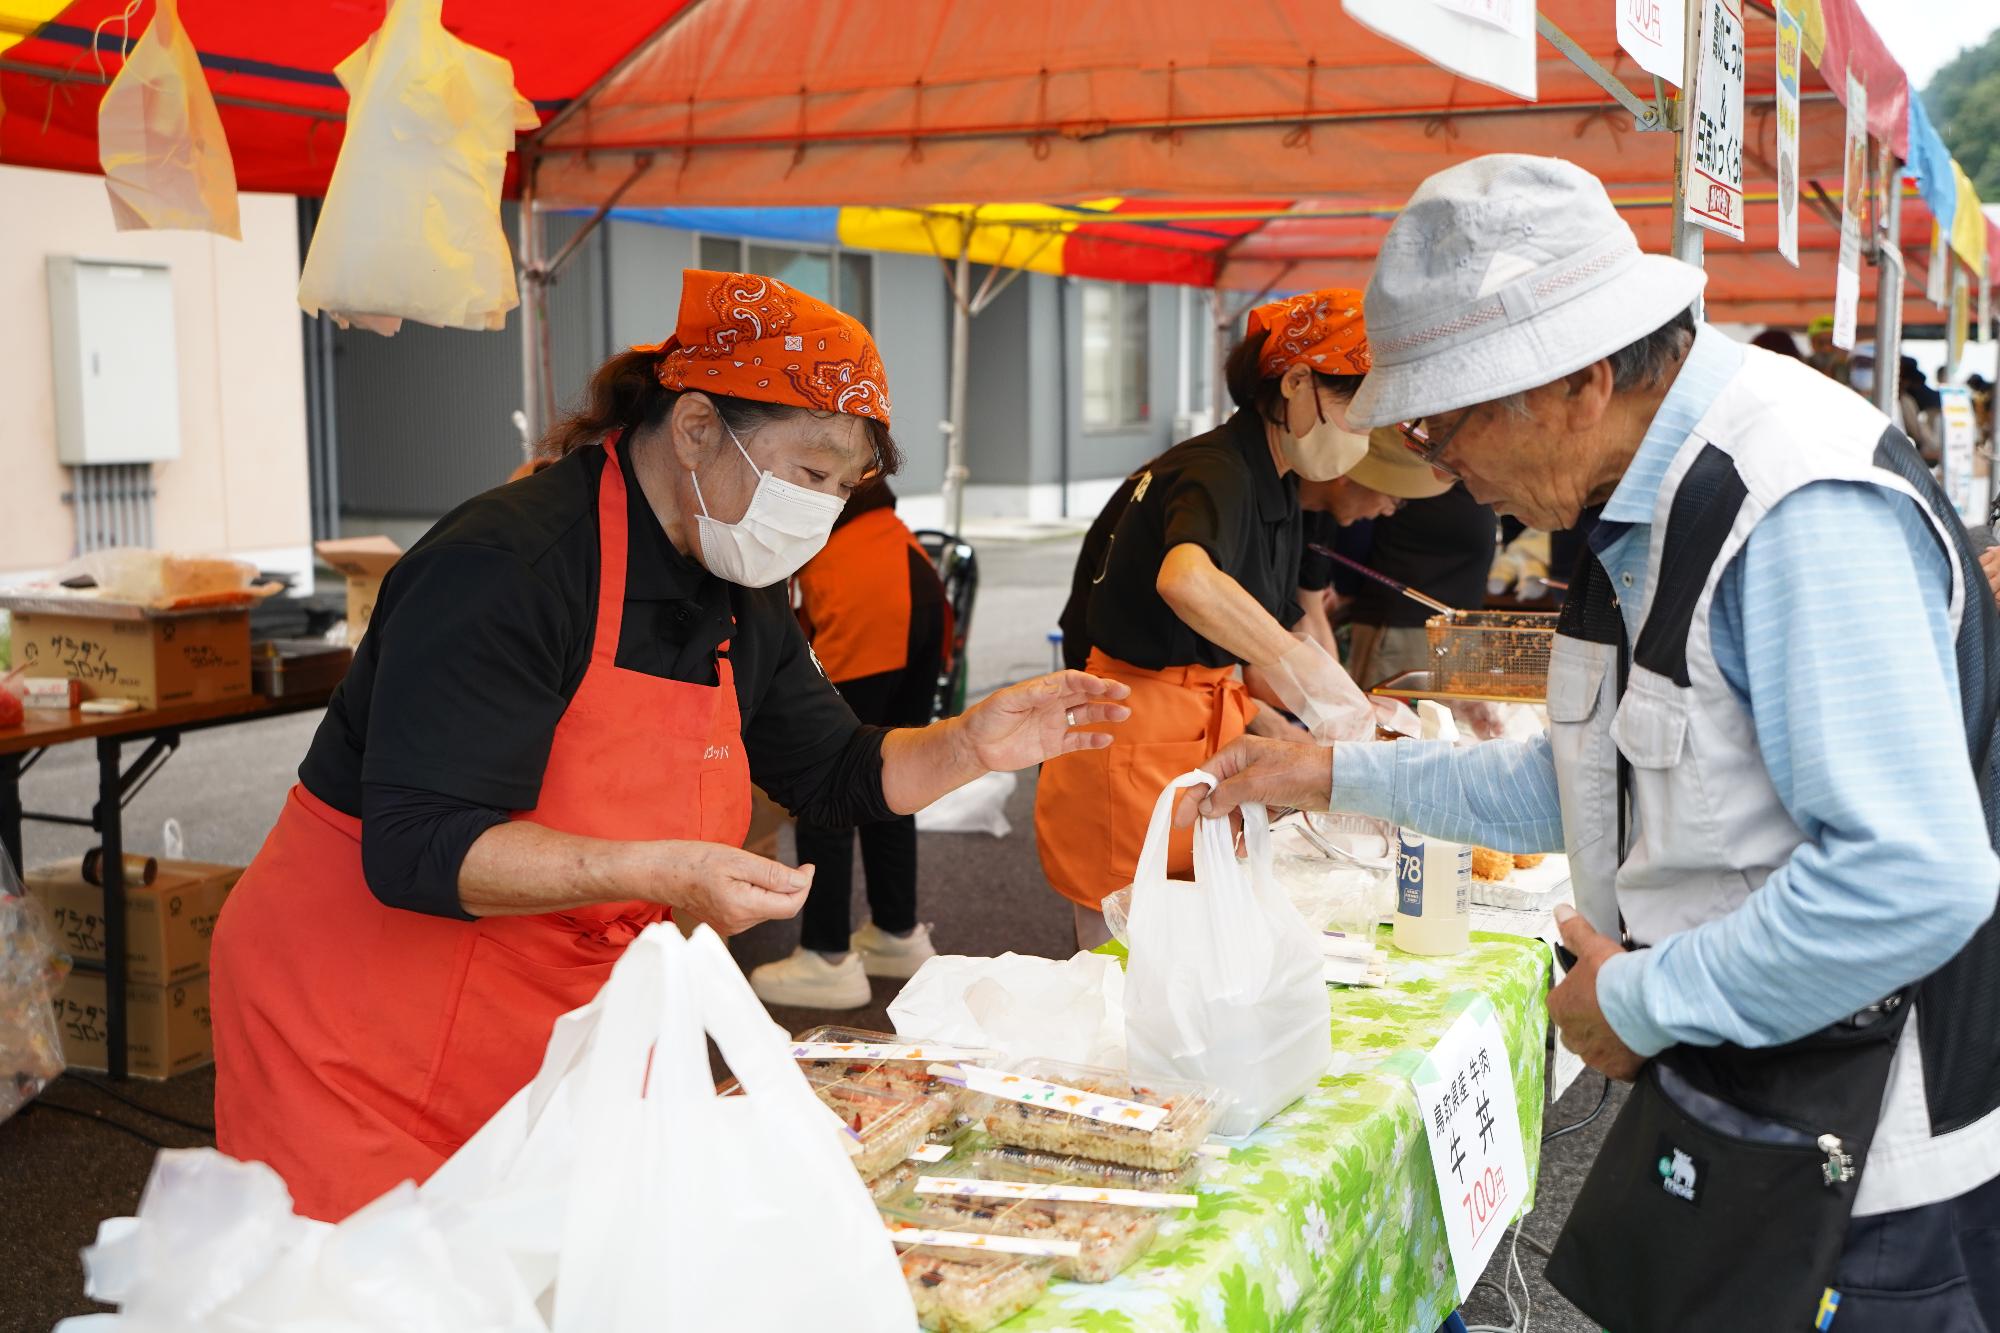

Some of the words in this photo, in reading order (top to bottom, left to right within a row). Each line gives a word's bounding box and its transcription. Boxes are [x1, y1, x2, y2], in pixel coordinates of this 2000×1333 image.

[1720, 83, 1727, 130] &
[1450, 1089, 1495, 1185] 牛丼
[1462, 1164, 1506, 1238] 700円
